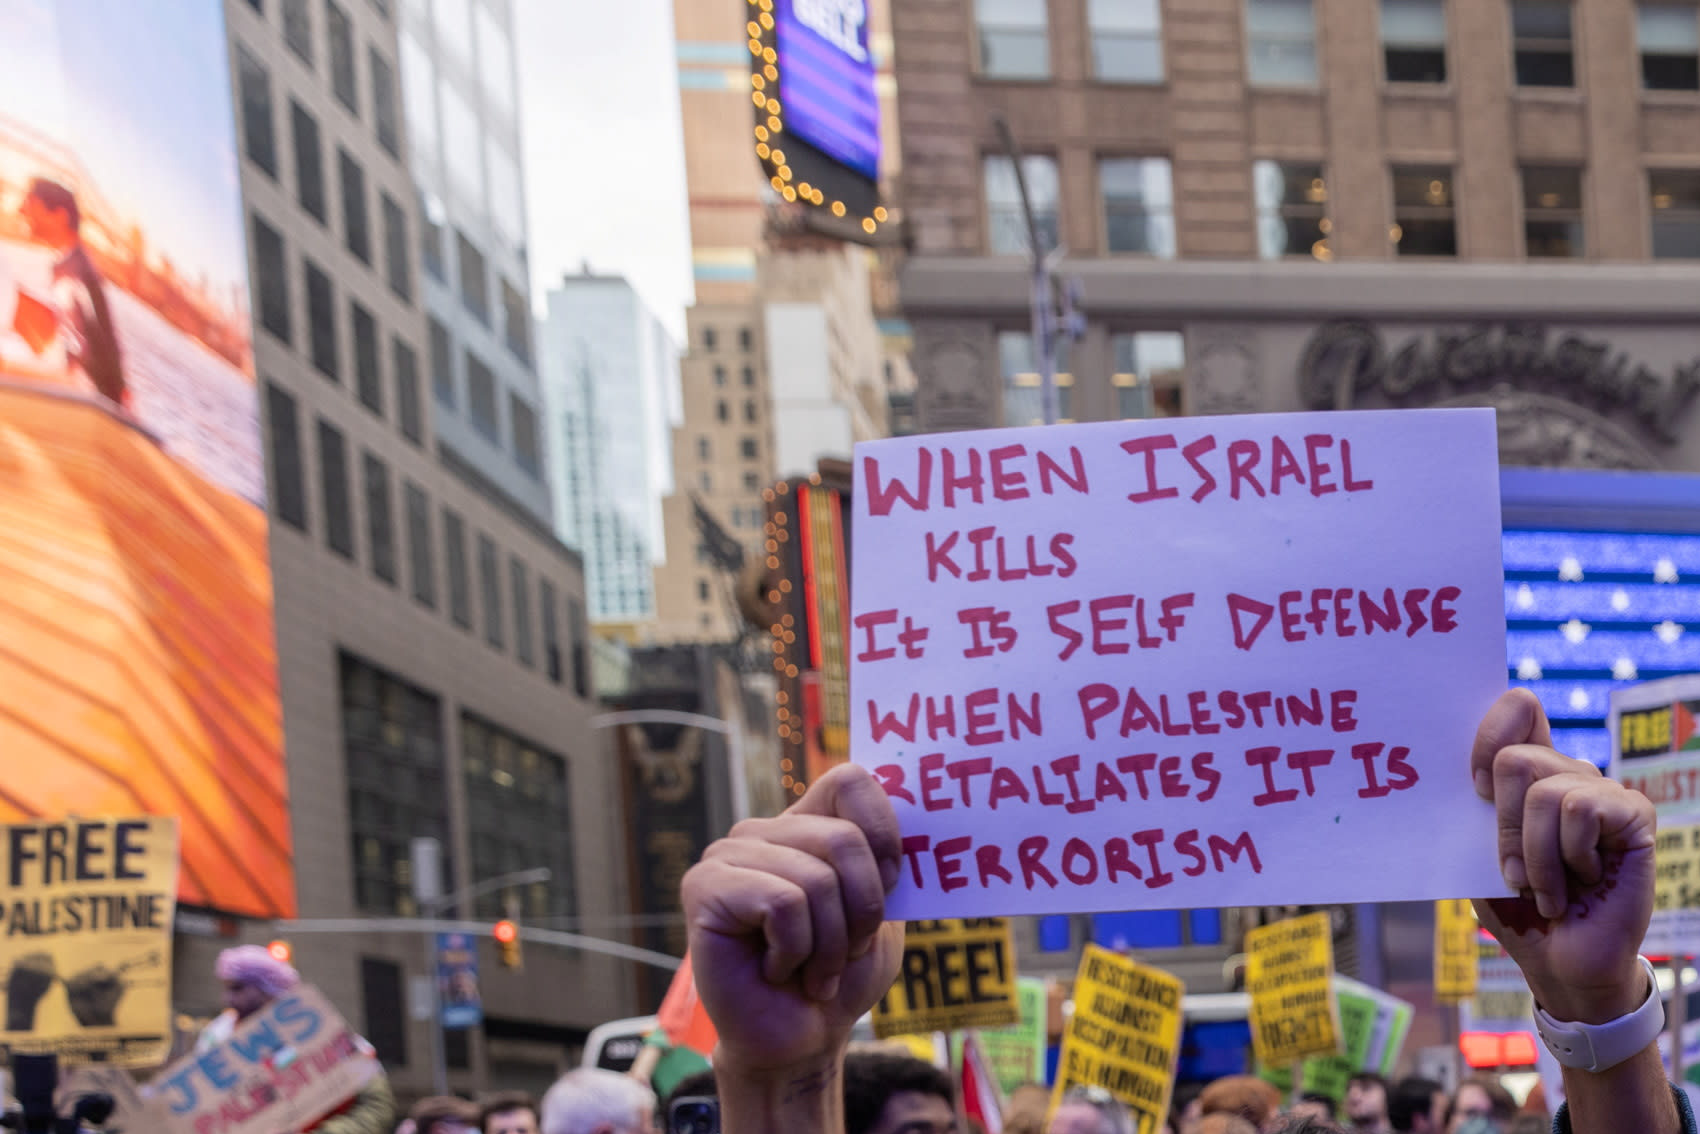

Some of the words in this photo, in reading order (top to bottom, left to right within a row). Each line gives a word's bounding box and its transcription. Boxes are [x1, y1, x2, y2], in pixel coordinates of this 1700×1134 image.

[862, 444, 1090, 516] WHEN
[1120, 433, 1374, 503] ISRAEL
[925, 525, 1077, 582] KILLS
[957, 606, 1018, 659] IS
[1226, 586, 1461, 651] DEFENSE
[867, 691, 1041, 746] WHEN
[1078, 683, 1358, 740] PALESTINE
[1620, 710, 1671, 752] FREE
[872, 752, 1222, 813] RETALIATES
[1244, 746, 1335, 807] IT
[1351, 741, 1420, 799] IS
[8, 822, 149, 887] FREE
[902, 829, 1263, 892] TERRORISM
[0, 894, 166, 936] ALESTINE
[160, 997, 322, 1114] JEWS
